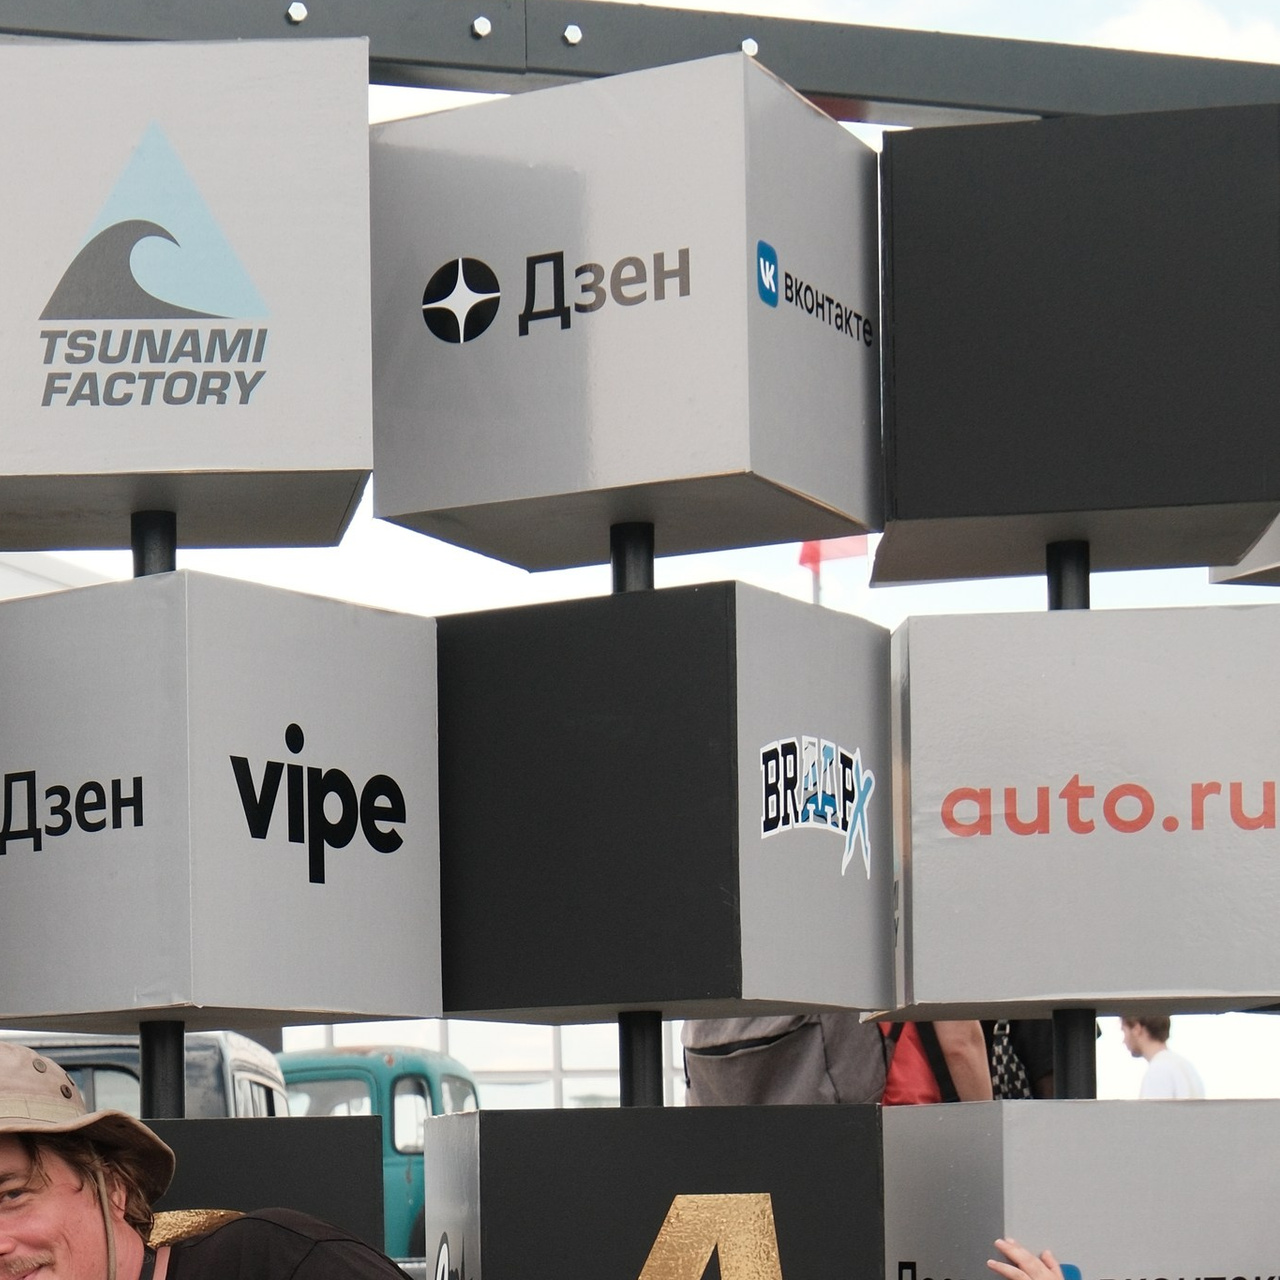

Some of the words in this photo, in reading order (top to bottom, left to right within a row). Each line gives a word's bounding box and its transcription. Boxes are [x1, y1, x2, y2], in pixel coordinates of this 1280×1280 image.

[518, 247, 691, 336] Дзен
[784, 271, 873, 347] вконтакте
[39, 328, 268, 364] TSUNAMI
[41, 370, 267, 407] FACTORY
[229, 723, 406, 884] vipe
[941, 774, 1277, 837] auto.ru
